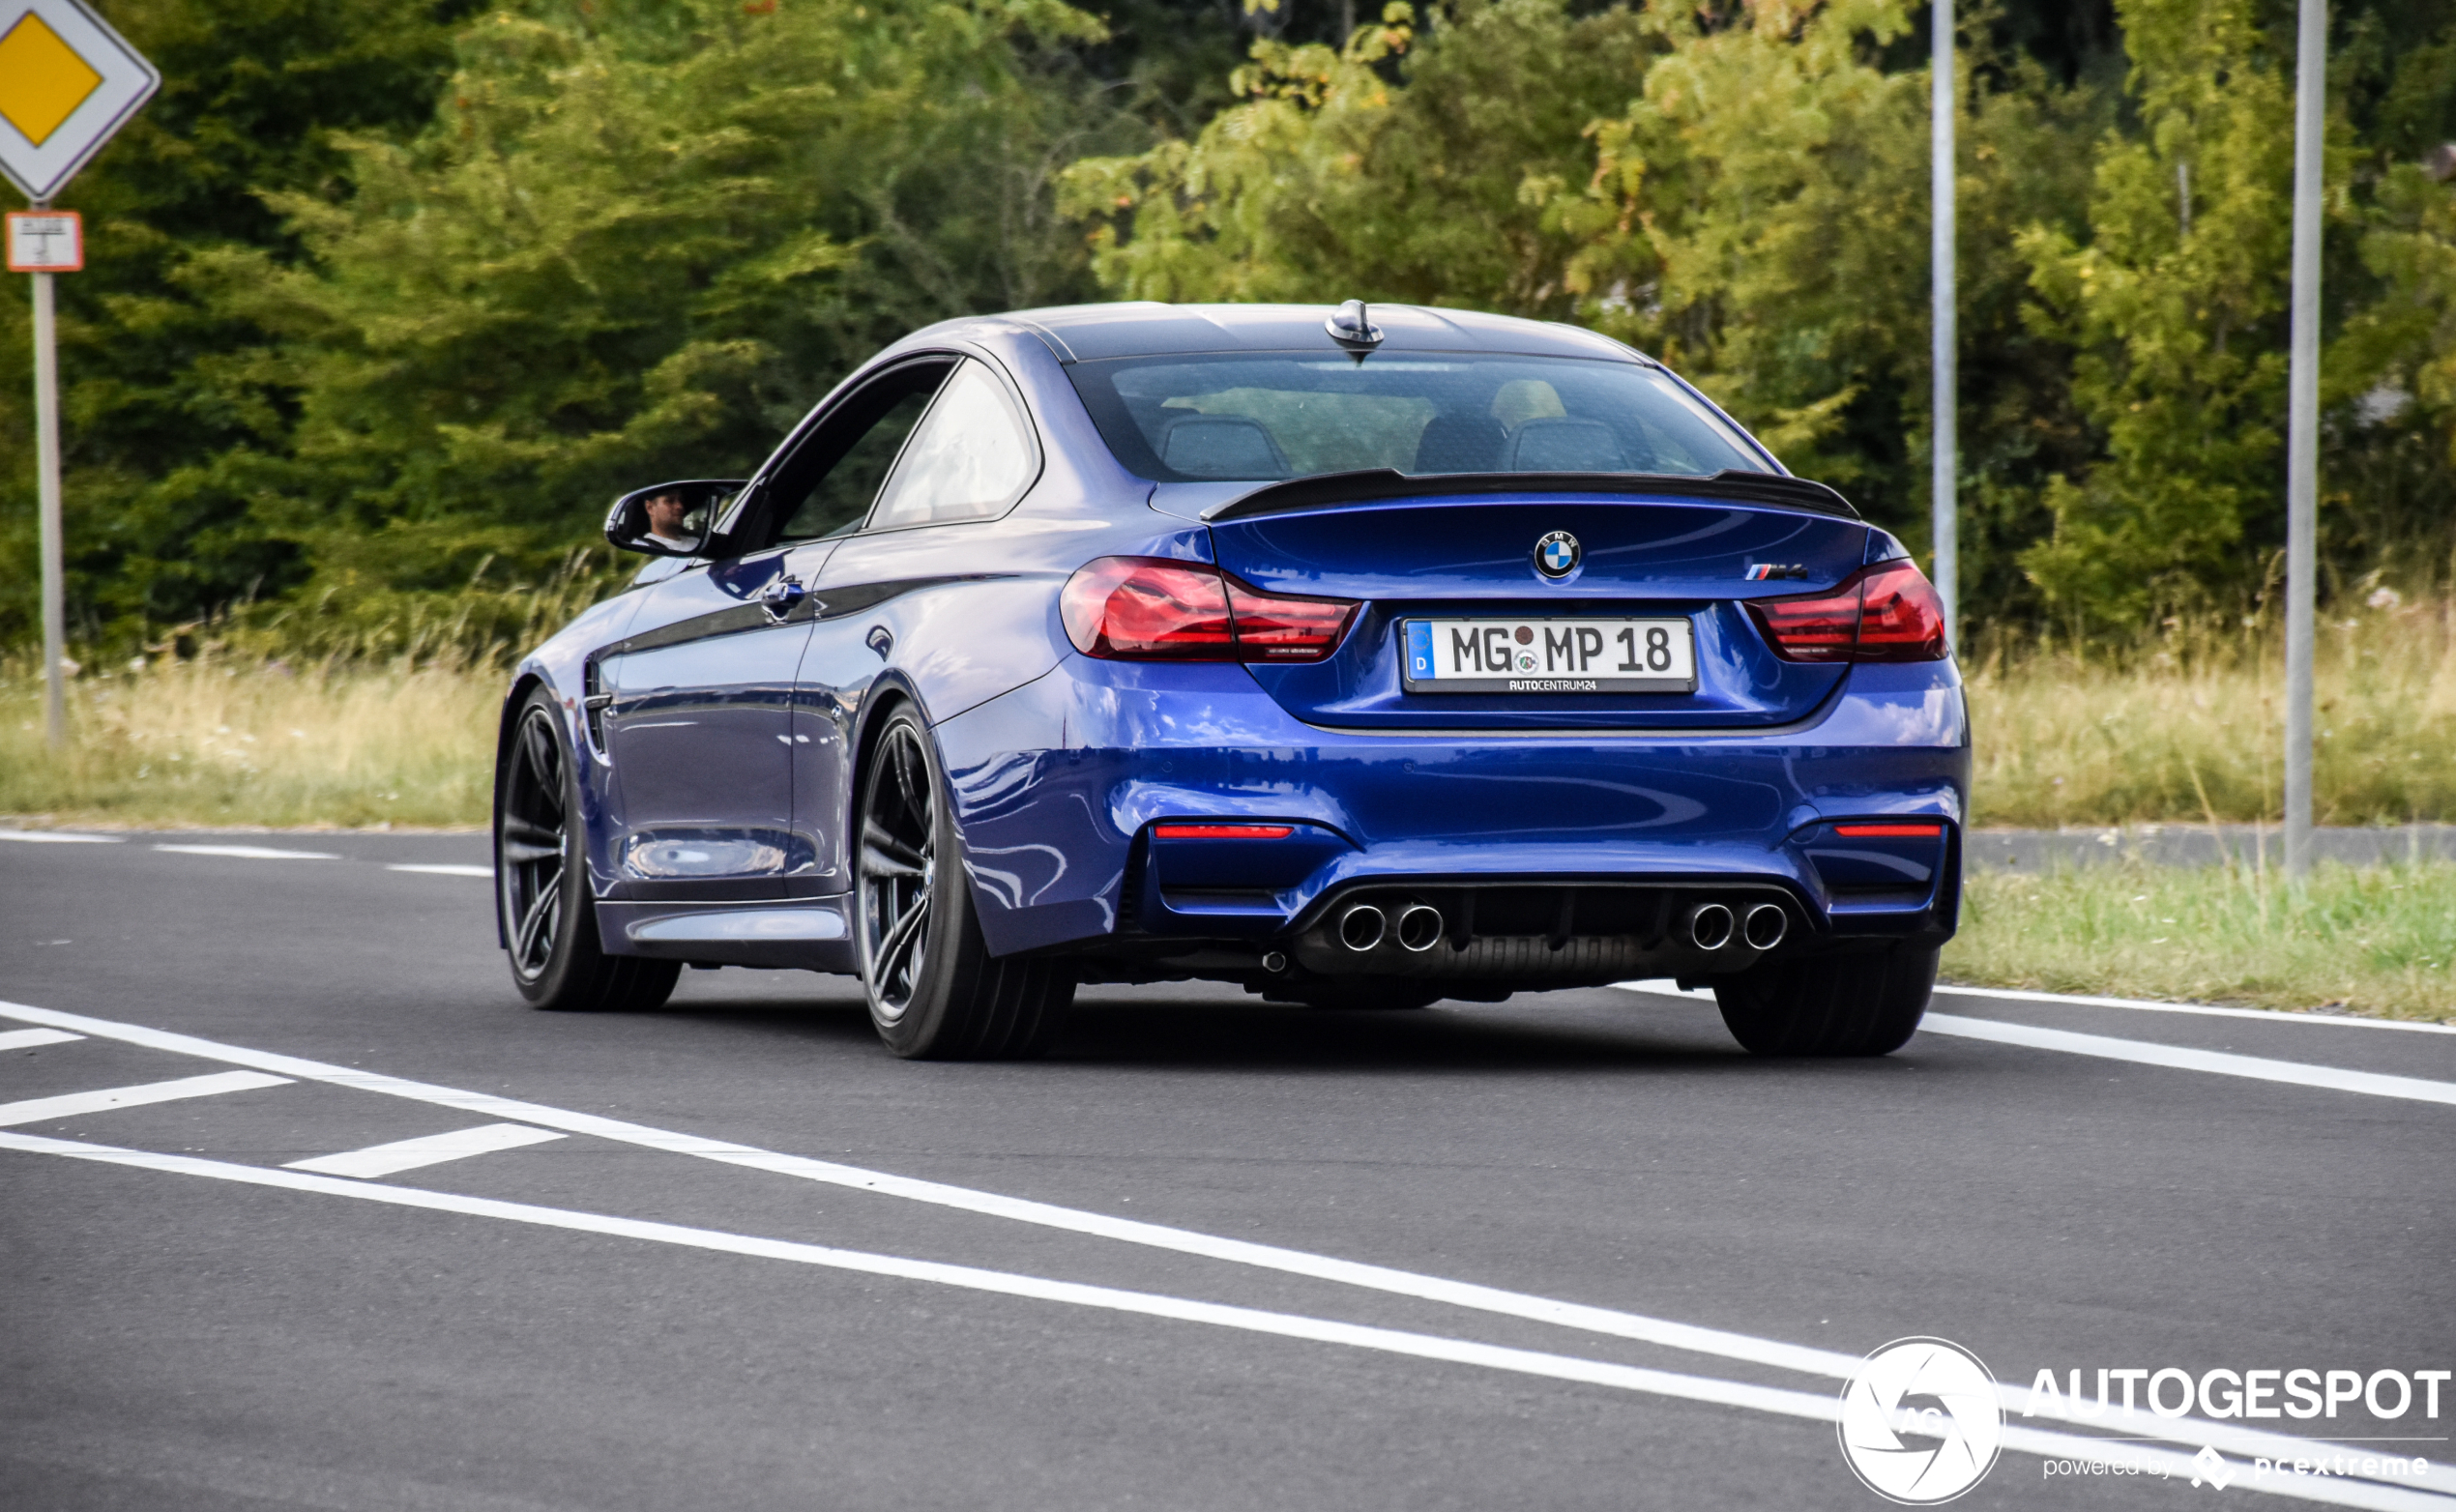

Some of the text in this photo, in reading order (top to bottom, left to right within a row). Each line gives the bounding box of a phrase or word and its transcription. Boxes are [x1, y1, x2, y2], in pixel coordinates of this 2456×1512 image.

[1540, 533, 1578, 548] BMW
[1450, 627, 1513, 672] MG
[1544, 626, 1603, 672] MP
[1616, 626, 1672, 672] 18
[1416, 657, 1426, 670] D
[1508, 680, 1597, 691] AUTOCENTRUM24
